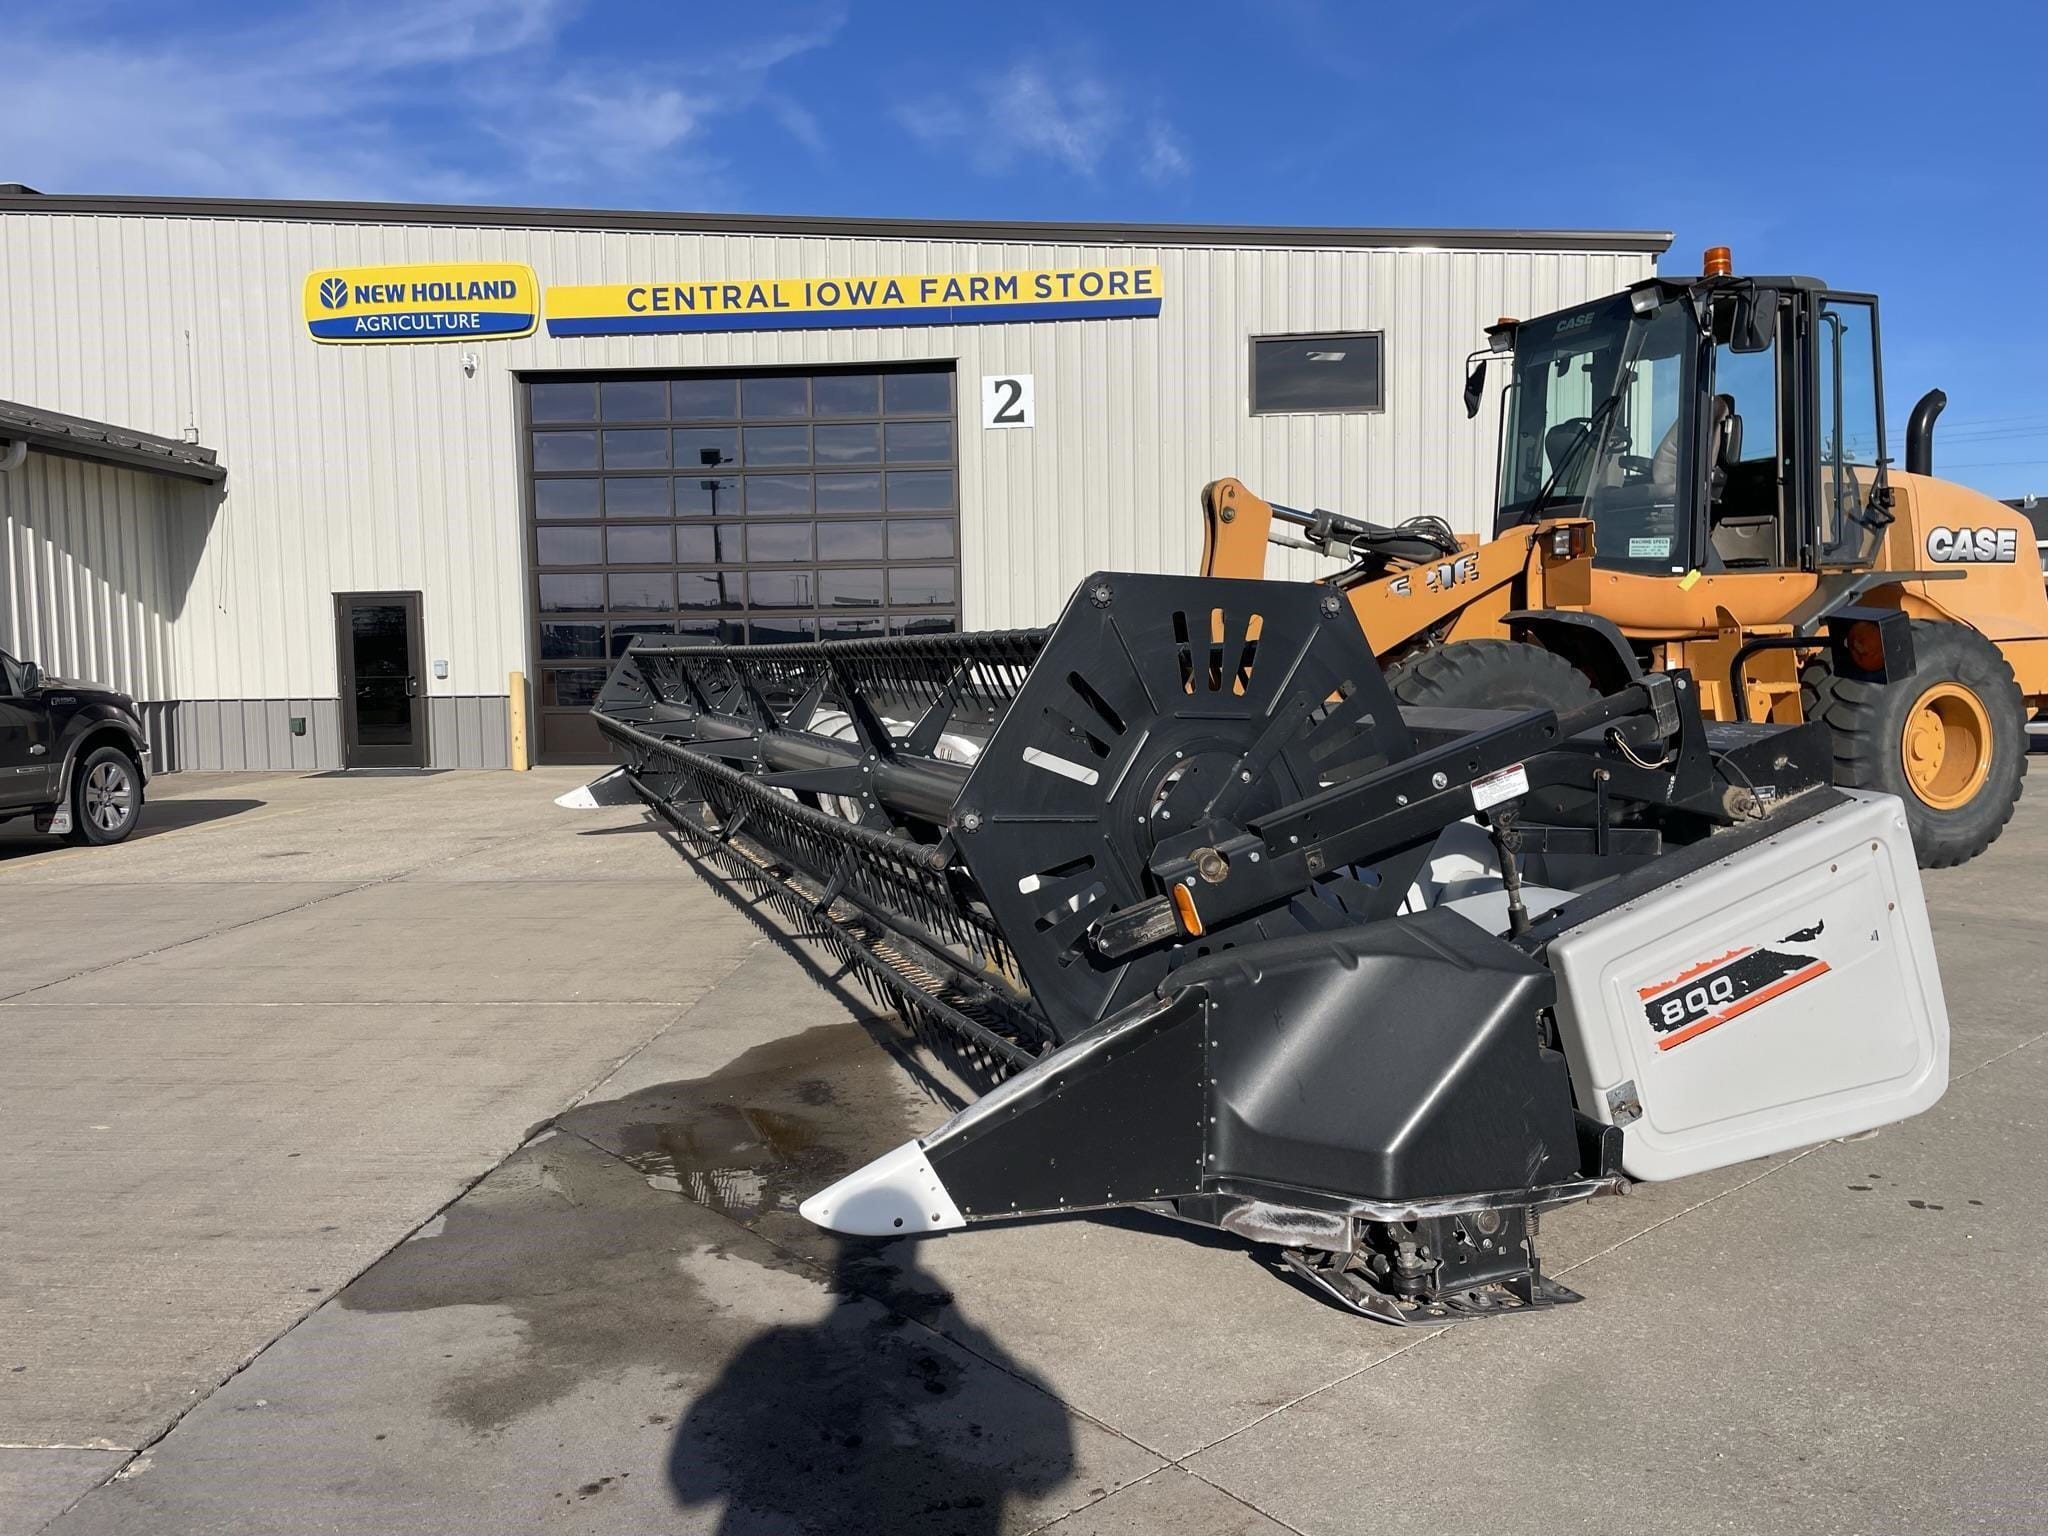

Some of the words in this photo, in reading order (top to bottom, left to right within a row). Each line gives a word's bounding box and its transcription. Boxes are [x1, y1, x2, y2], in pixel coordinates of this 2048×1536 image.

[354, 284, 406, 304] NEW
[411, 280, 517, 302] HOLLAND
[627, 284, 790, 312] CENTRAL
[805, 280, 905, 306] IOWA
[920, 275, 1018, 303] FARM
[1034, 270, 1153, 298] STORE
[354, 313, 481, 332] AGRICULTURE
[1556, 311, 1596, 332] CASE
[992, 379, 1025, 423] 2
[1927, 526, 2018, 563] CASE
[1661, 975, 1733, 1025] 800
